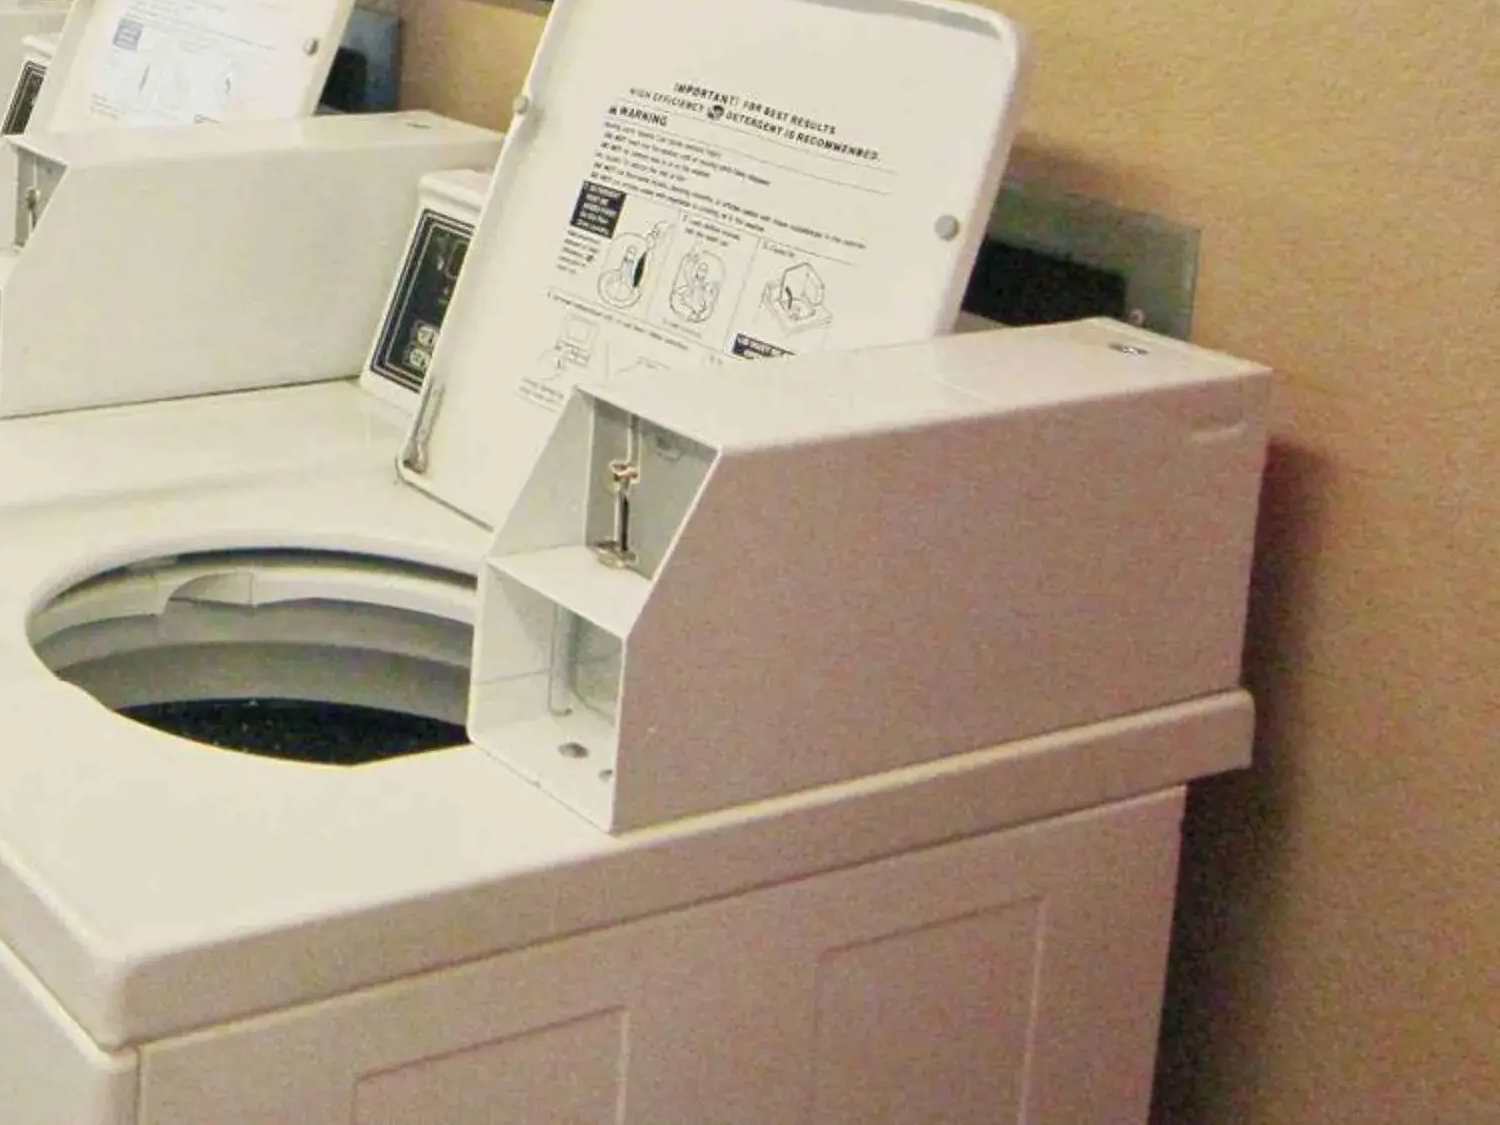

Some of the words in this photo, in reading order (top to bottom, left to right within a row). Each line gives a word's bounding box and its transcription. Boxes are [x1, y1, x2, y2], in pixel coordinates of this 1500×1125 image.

[618, 105, 668, 127] WARNING
[652, 90, 704, 112] EFFICIENCY
[725, 108, 783, 136] DETERGENT
[784, 125, 795, 140] IS
[742, 98, 763, 114] FOR
[764, 104, 788, 122] BEST
[789, 111, 836, 135] RESULTS
